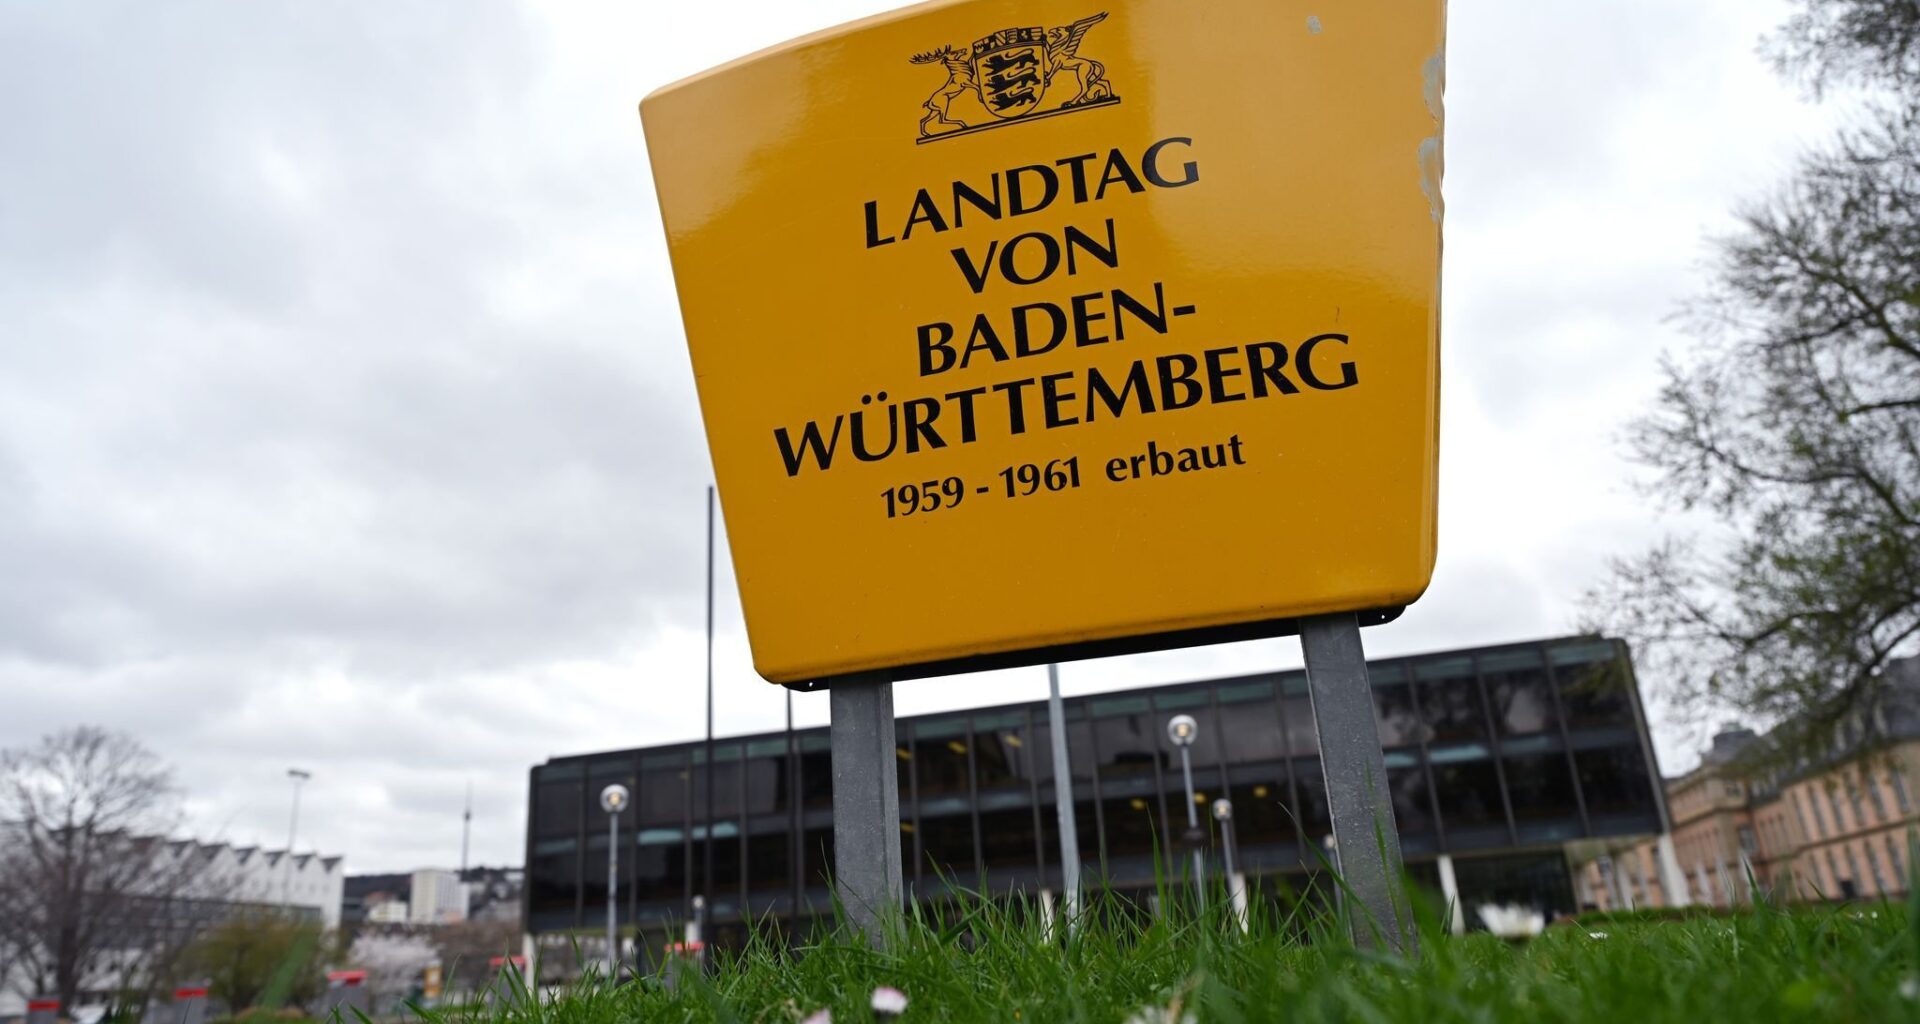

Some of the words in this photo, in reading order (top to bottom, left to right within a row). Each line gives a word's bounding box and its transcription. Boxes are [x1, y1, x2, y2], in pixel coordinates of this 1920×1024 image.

[864, 136, 1200, 249] LANDTAG
[950, 218, 1119, 294] VON
[917, 282, 1196, 377] BADEN-
[773, 333, 1359, 477] WÜRTTEMBERG
[880, 476, 965, 519] 1959
[999, 456, 1081, 499] 1961
[1105, 434, 1247, 483] erbaut
